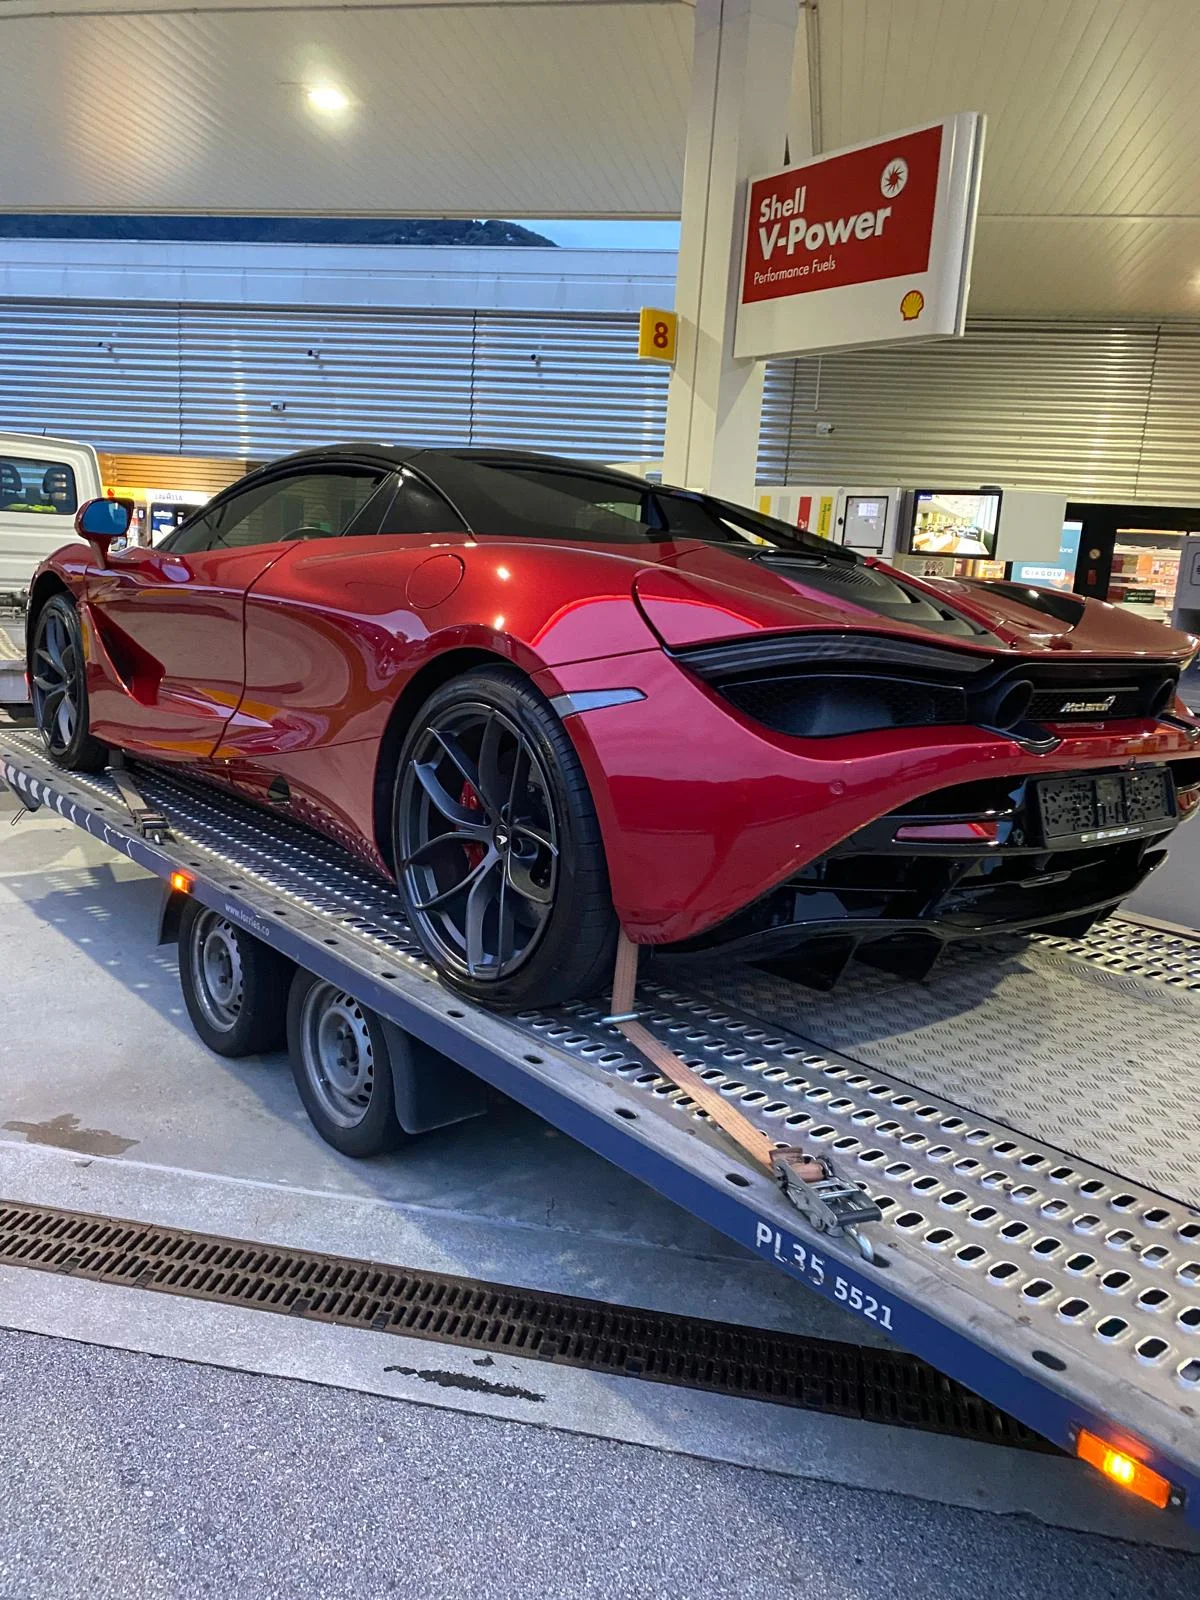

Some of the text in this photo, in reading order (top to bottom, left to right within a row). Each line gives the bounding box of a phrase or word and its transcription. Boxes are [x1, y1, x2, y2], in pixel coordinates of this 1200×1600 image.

[760, 186, 806, 223] Shell
[759, 206, 892, 260] V-Power
[753, 254, 836, 285] Performance Fuels
[653, 322, 669, 349] 8
[1060, 702, 1109, 712] McLaren
[834, 1276, 893, 1331] 5521
